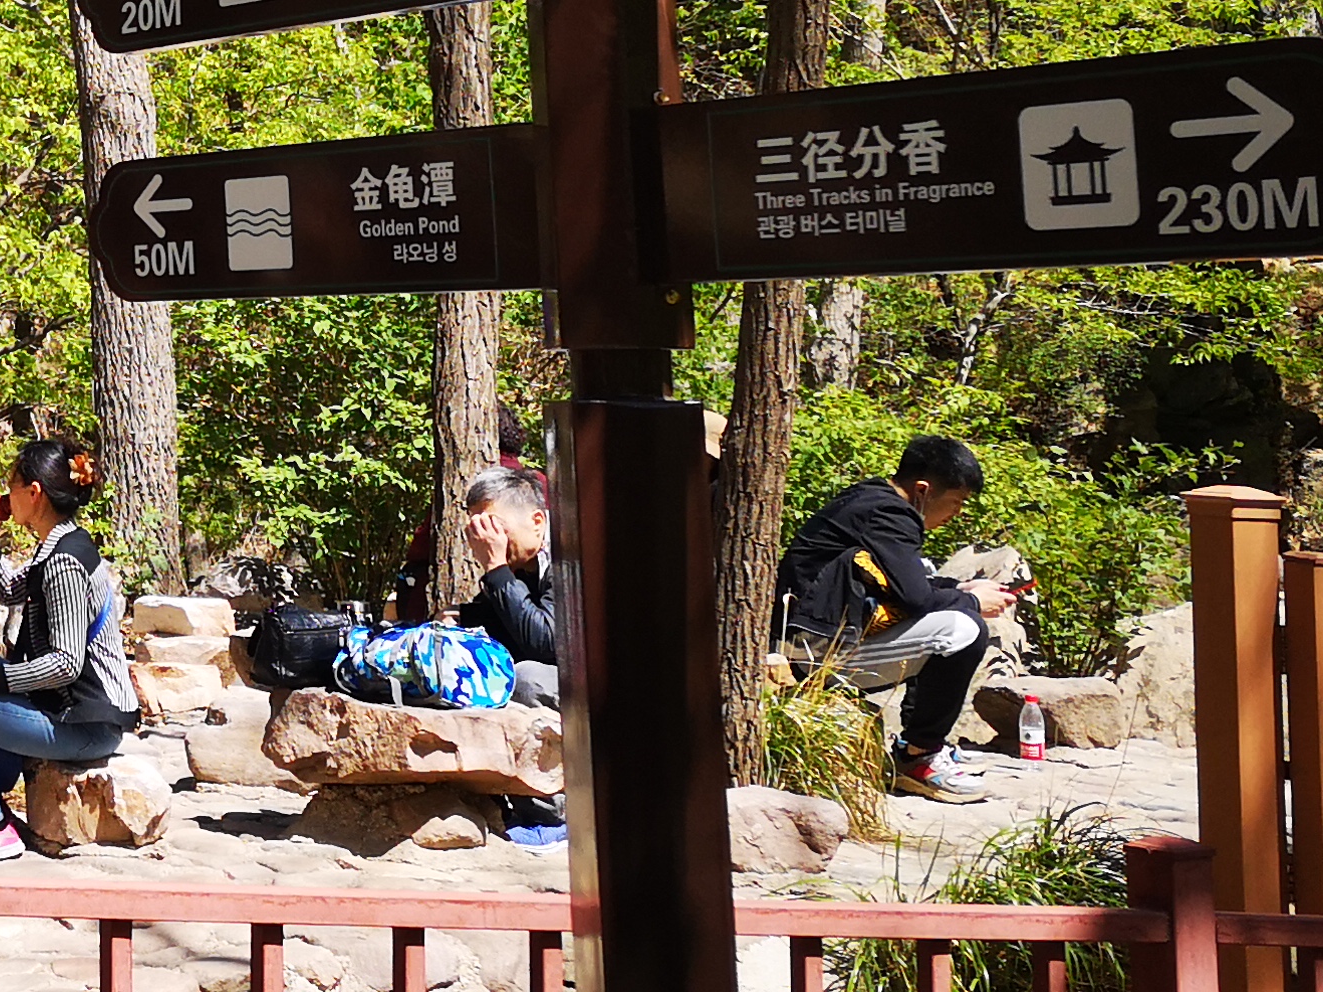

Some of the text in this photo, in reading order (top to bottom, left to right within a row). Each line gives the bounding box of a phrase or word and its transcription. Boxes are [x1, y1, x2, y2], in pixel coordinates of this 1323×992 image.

[755, 119, 948, 184] 三径分香
[349, 161, 457, 211] 金龟潭
[754, 180, 995, 210] Three Tracks in Fragrance
[757, 208, 907, 240] 관광 버스 터미널
[1157, 176, 1320, 235] 230M
[359, 214, 460, 238] Golden Pond
[133, 240, 195, 278] 50M
